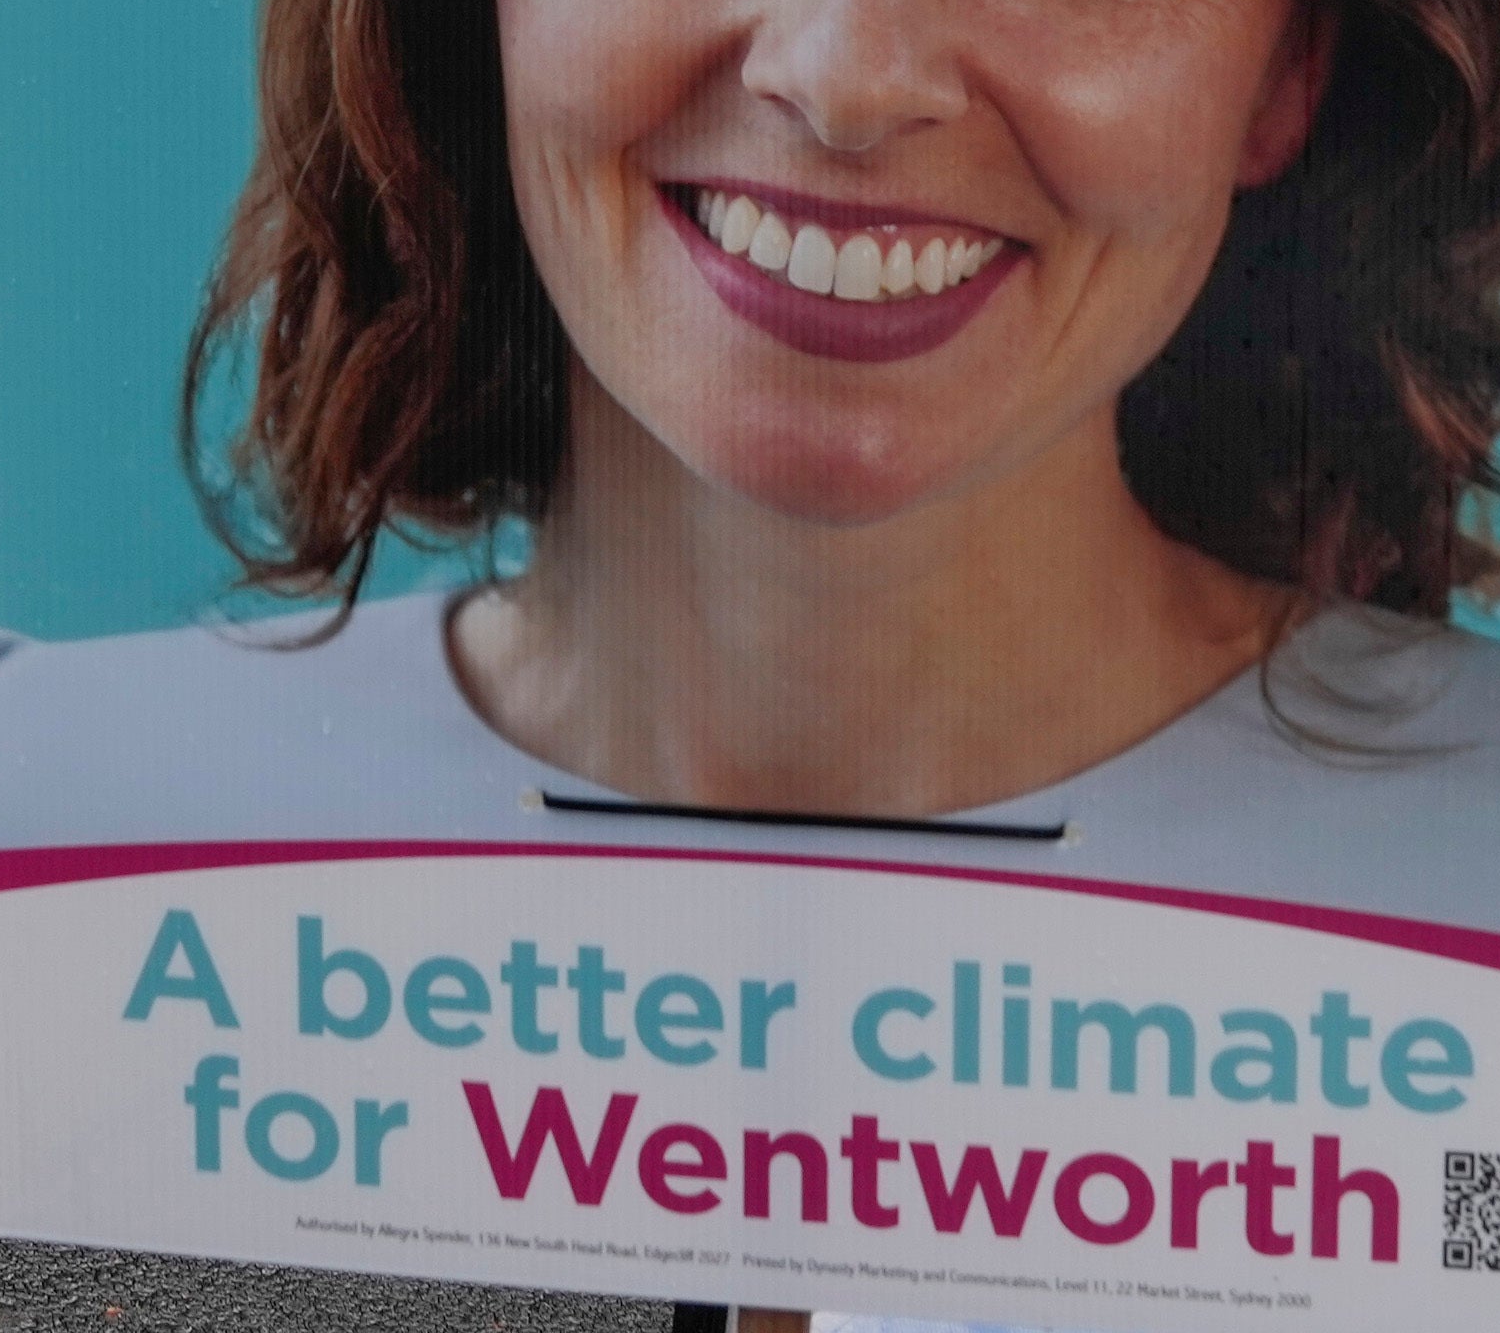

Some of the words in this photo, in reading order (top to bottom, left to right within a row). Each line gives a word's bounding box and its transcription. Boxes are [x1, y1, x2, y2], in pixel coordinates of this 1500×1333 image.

[122, 910, 240, 1030] A
[297, 916, 796, 1071] better
[852, 961, 1474, 1114] climate
[185, 1056, 408, 1189] for
[462, 1082, 1402, 1265] Wentworth
[361, 1222, 375, 1237] by
[378, 1224, 419, 1242] Allegra
[505, 1234, 530, 1248] New
[534, 1236, 567, 1251] South
[571, 1239, 603, 1255] Head
[699, 1249, 730, 1266] 2027
[743, 1253, 786, 1270] Printed
[789, 1256, 803, 1274] by
[807, 1257, 854, 1277] Dynasty
[858, 1261, 919, 1283] Marketing
[923, 1268, 945, 1283] and
[1056, 1276, 1088, 1294] Level
[1116, 1281, 1134, 1297] 22
[1138, 1282, 1180, 1300] Market
[1229, 1289, 1271, 1308] Sydney
[1277, 1292, 1311, 1310] 2000
